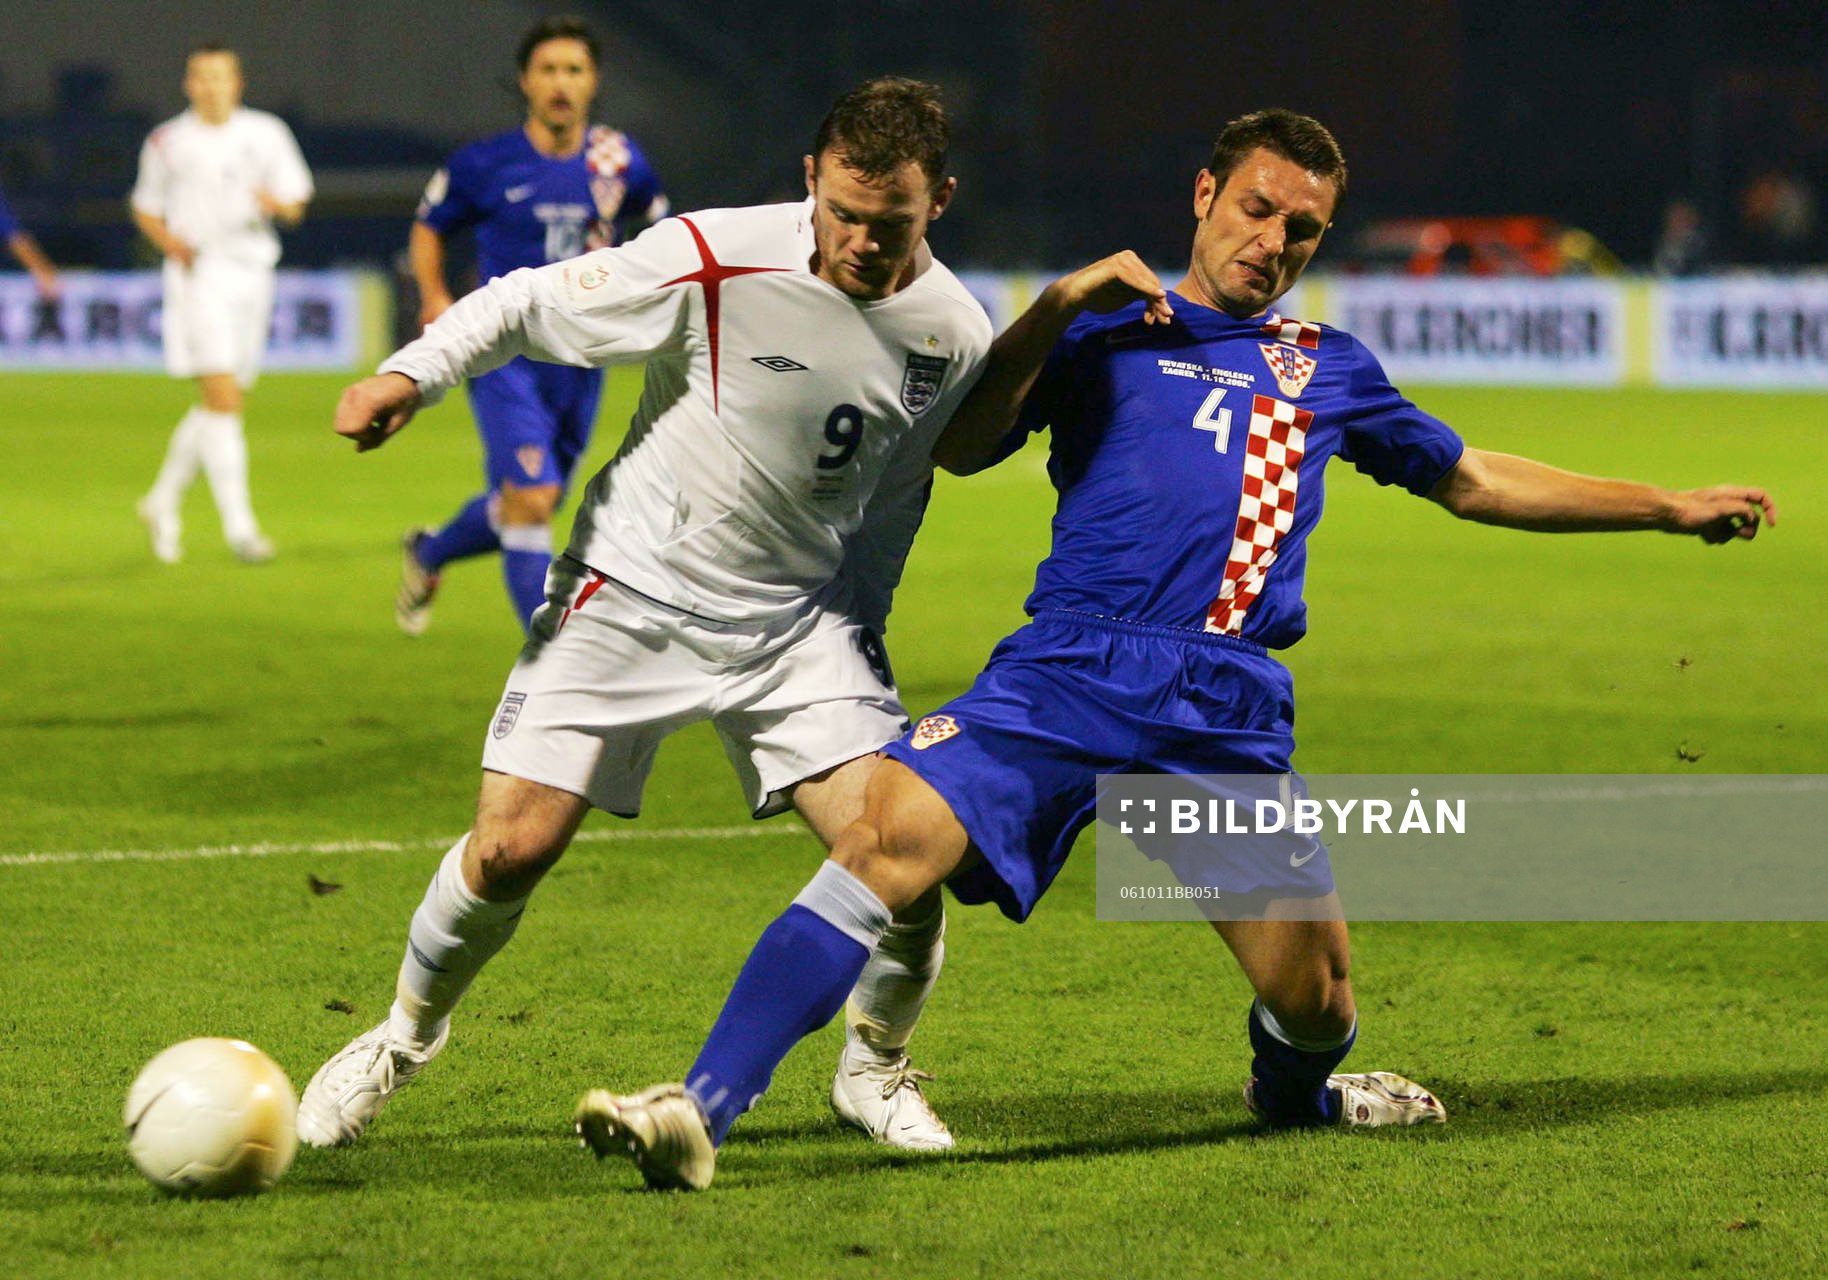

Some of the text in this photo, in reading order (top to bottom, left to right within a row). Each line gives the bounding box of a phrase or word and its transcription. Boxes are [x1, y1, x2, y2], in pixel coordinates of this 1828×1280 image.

[1158, 359, 1203, 372] HRVATSKA
[1212, 368, 1255, 382] ENGLESKA
[817, 403, 864, 470] 9
[1192, 387, 1232, 454] 4
